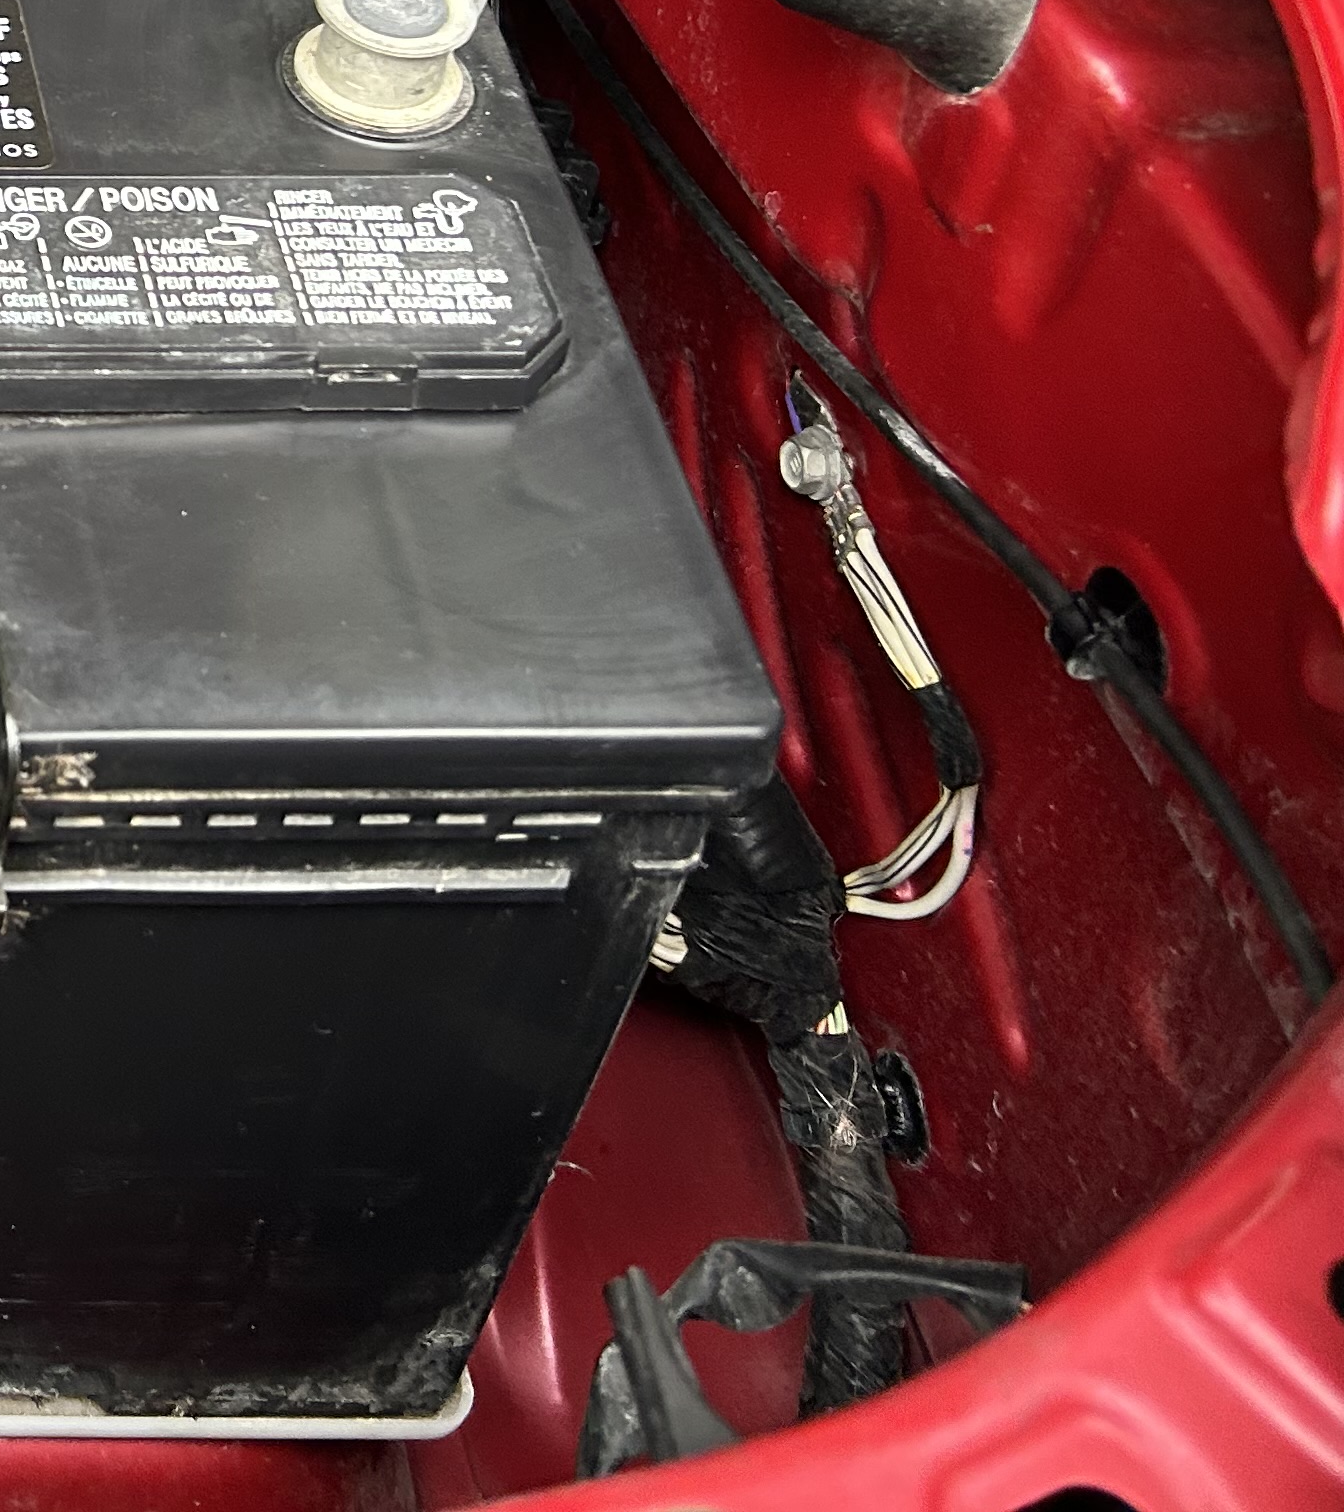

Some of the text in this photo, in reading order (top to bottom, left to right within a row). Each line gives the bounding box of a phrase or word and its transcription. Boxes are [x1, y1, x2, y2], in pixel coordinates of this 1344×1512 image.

[98, 186, 220, 213] POISON
[283, 222, 314, 237] LES
[62, 255, 138, 273] AUCUNE
[150, 255, 252, 273] SULFURIQUE
